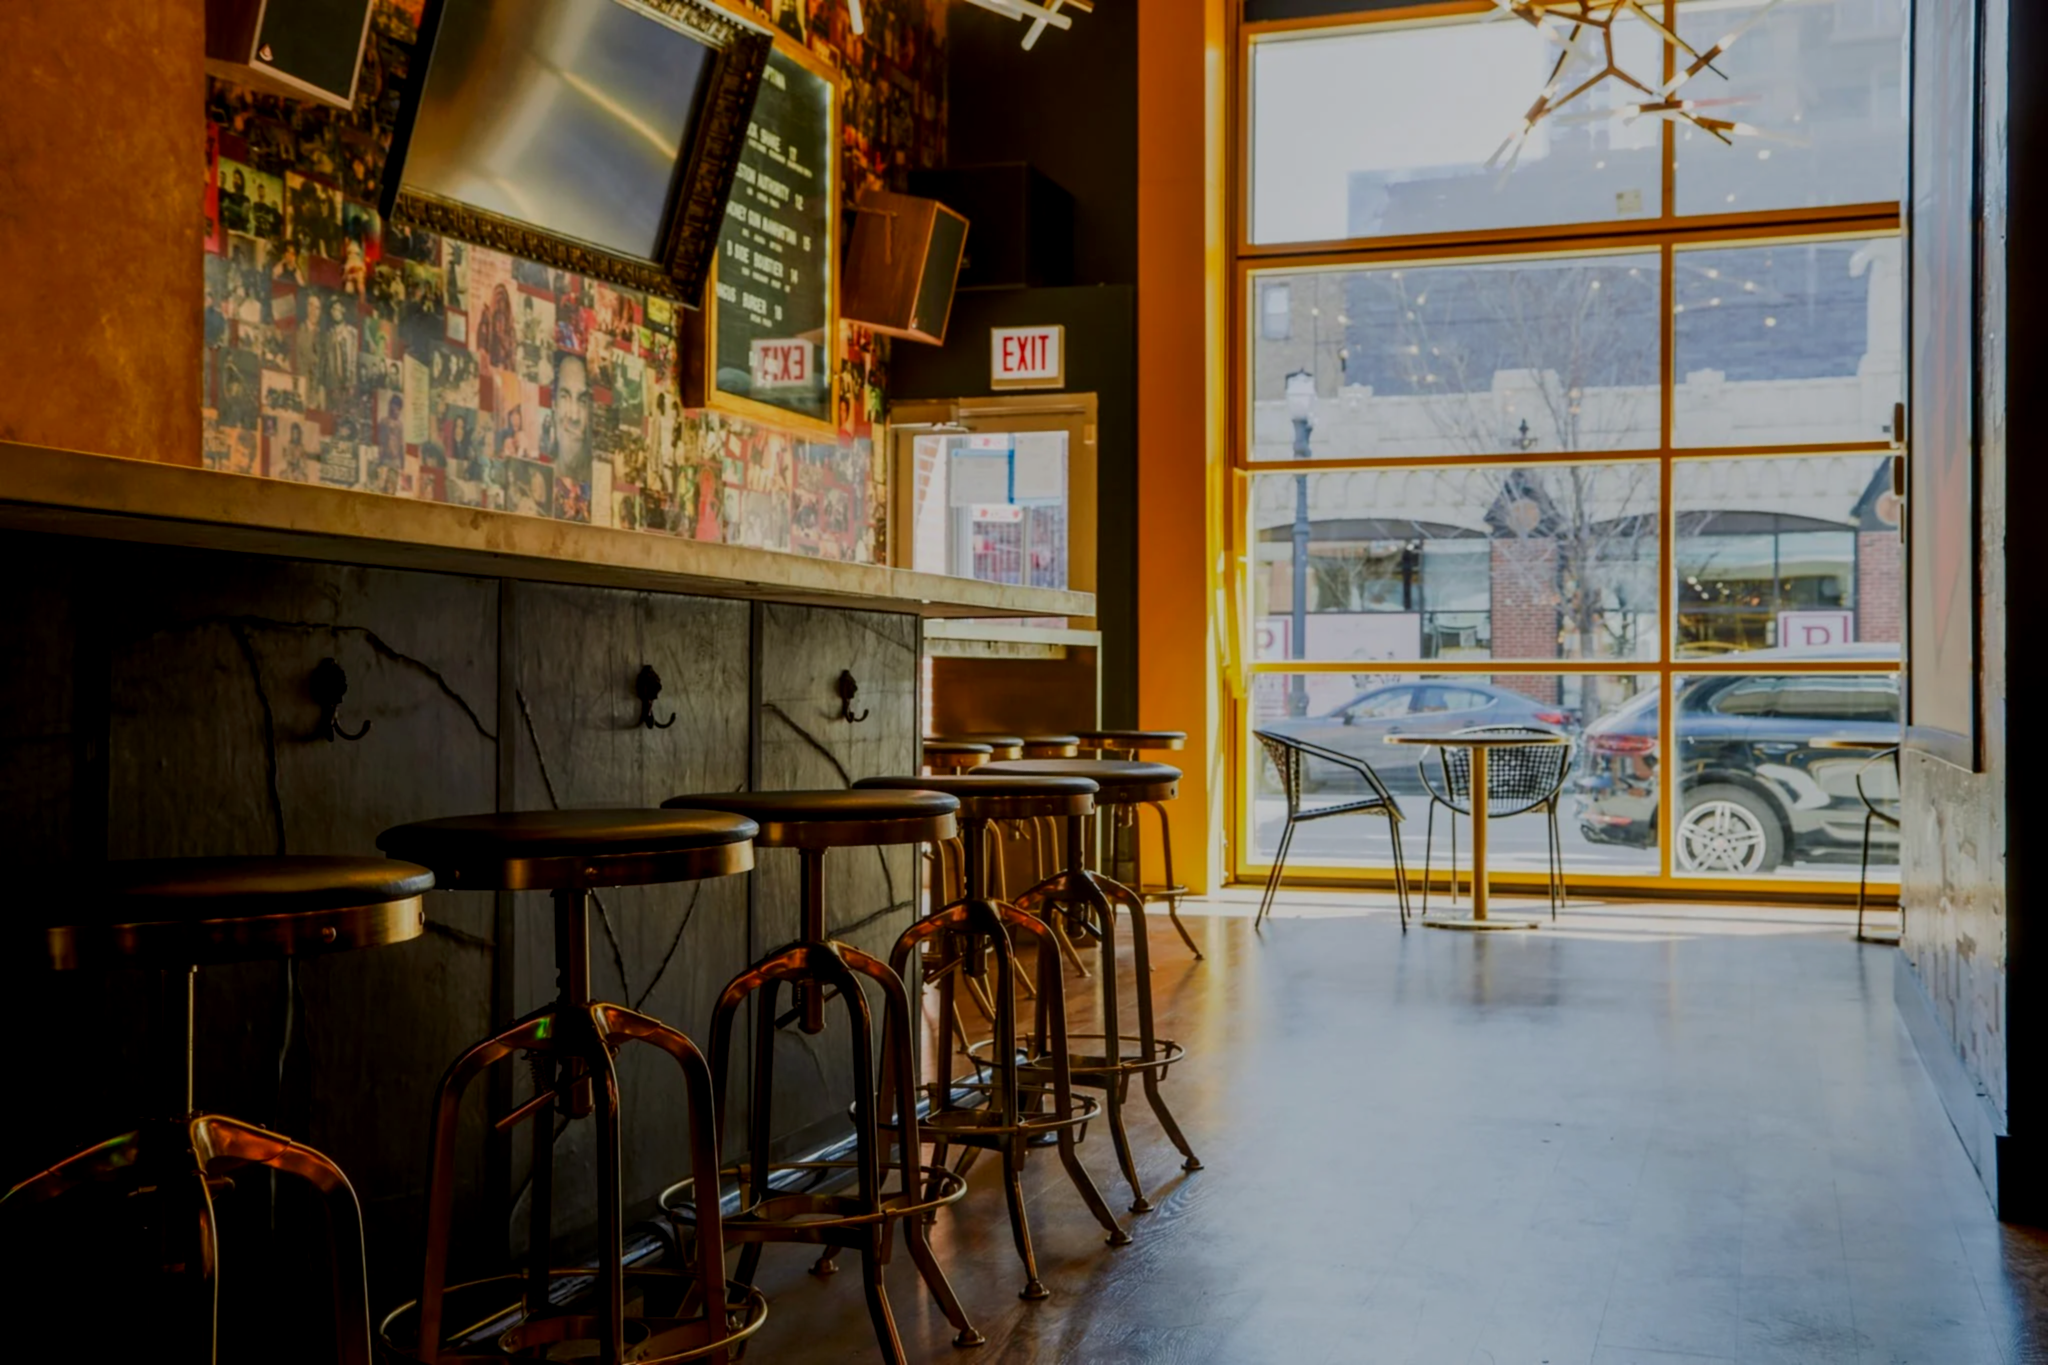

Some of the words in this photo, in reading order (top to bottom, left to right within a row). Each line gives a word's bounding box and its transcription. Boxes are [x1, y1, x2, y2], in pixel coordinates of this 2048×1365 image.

[716, 282, 736, 303] NGUS
[742, 291, 767, 316] BURGER
[1003, 335, 1049, 371] EXIT
